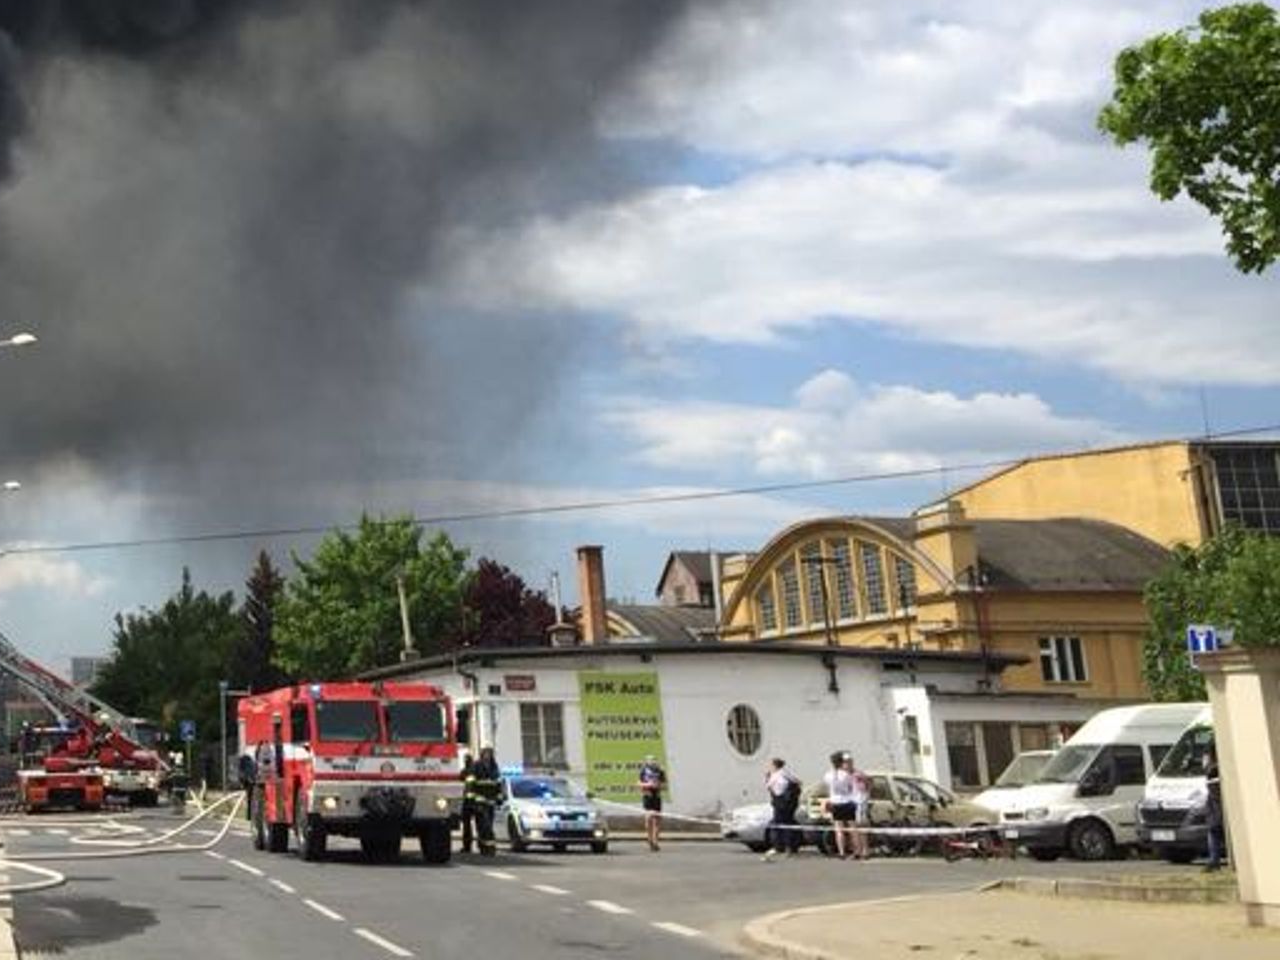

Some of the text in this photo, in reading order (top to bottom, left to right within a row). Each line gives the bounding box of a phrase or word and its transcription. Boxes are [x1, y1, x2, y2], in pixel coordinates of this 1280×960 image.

[620, 681, 654, 694] Auto
[587, 715, 658, 725] AUTOSERVIS
[587, 730, 661, 740] PNEUSERVIS
